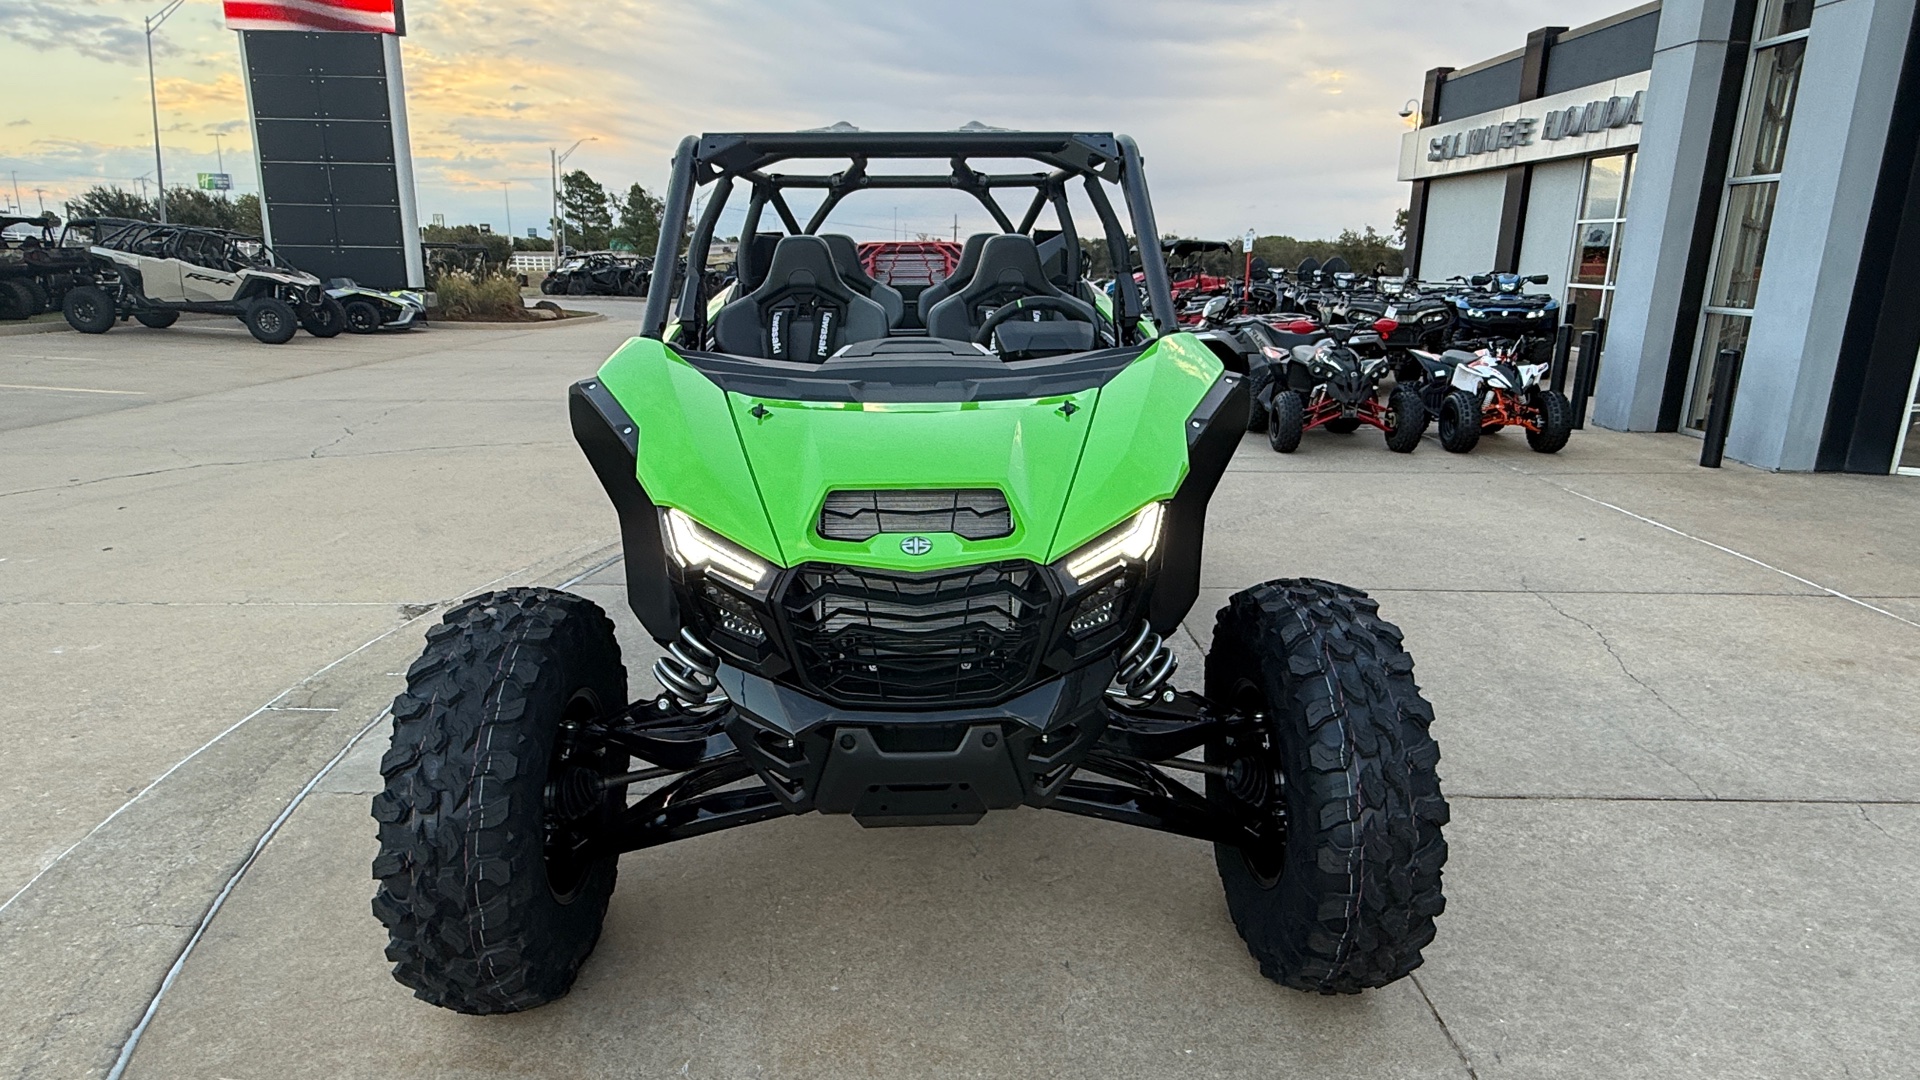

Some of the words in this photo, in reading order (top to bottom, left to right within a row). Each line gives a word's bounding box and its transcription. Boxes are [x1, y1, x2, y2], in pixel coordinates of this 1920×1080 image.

[1541, 90, 1646, 140] HONDA
[771, 311, 783, 354] Kawasaki
[817, 311, 833, 356] Kawasaki
